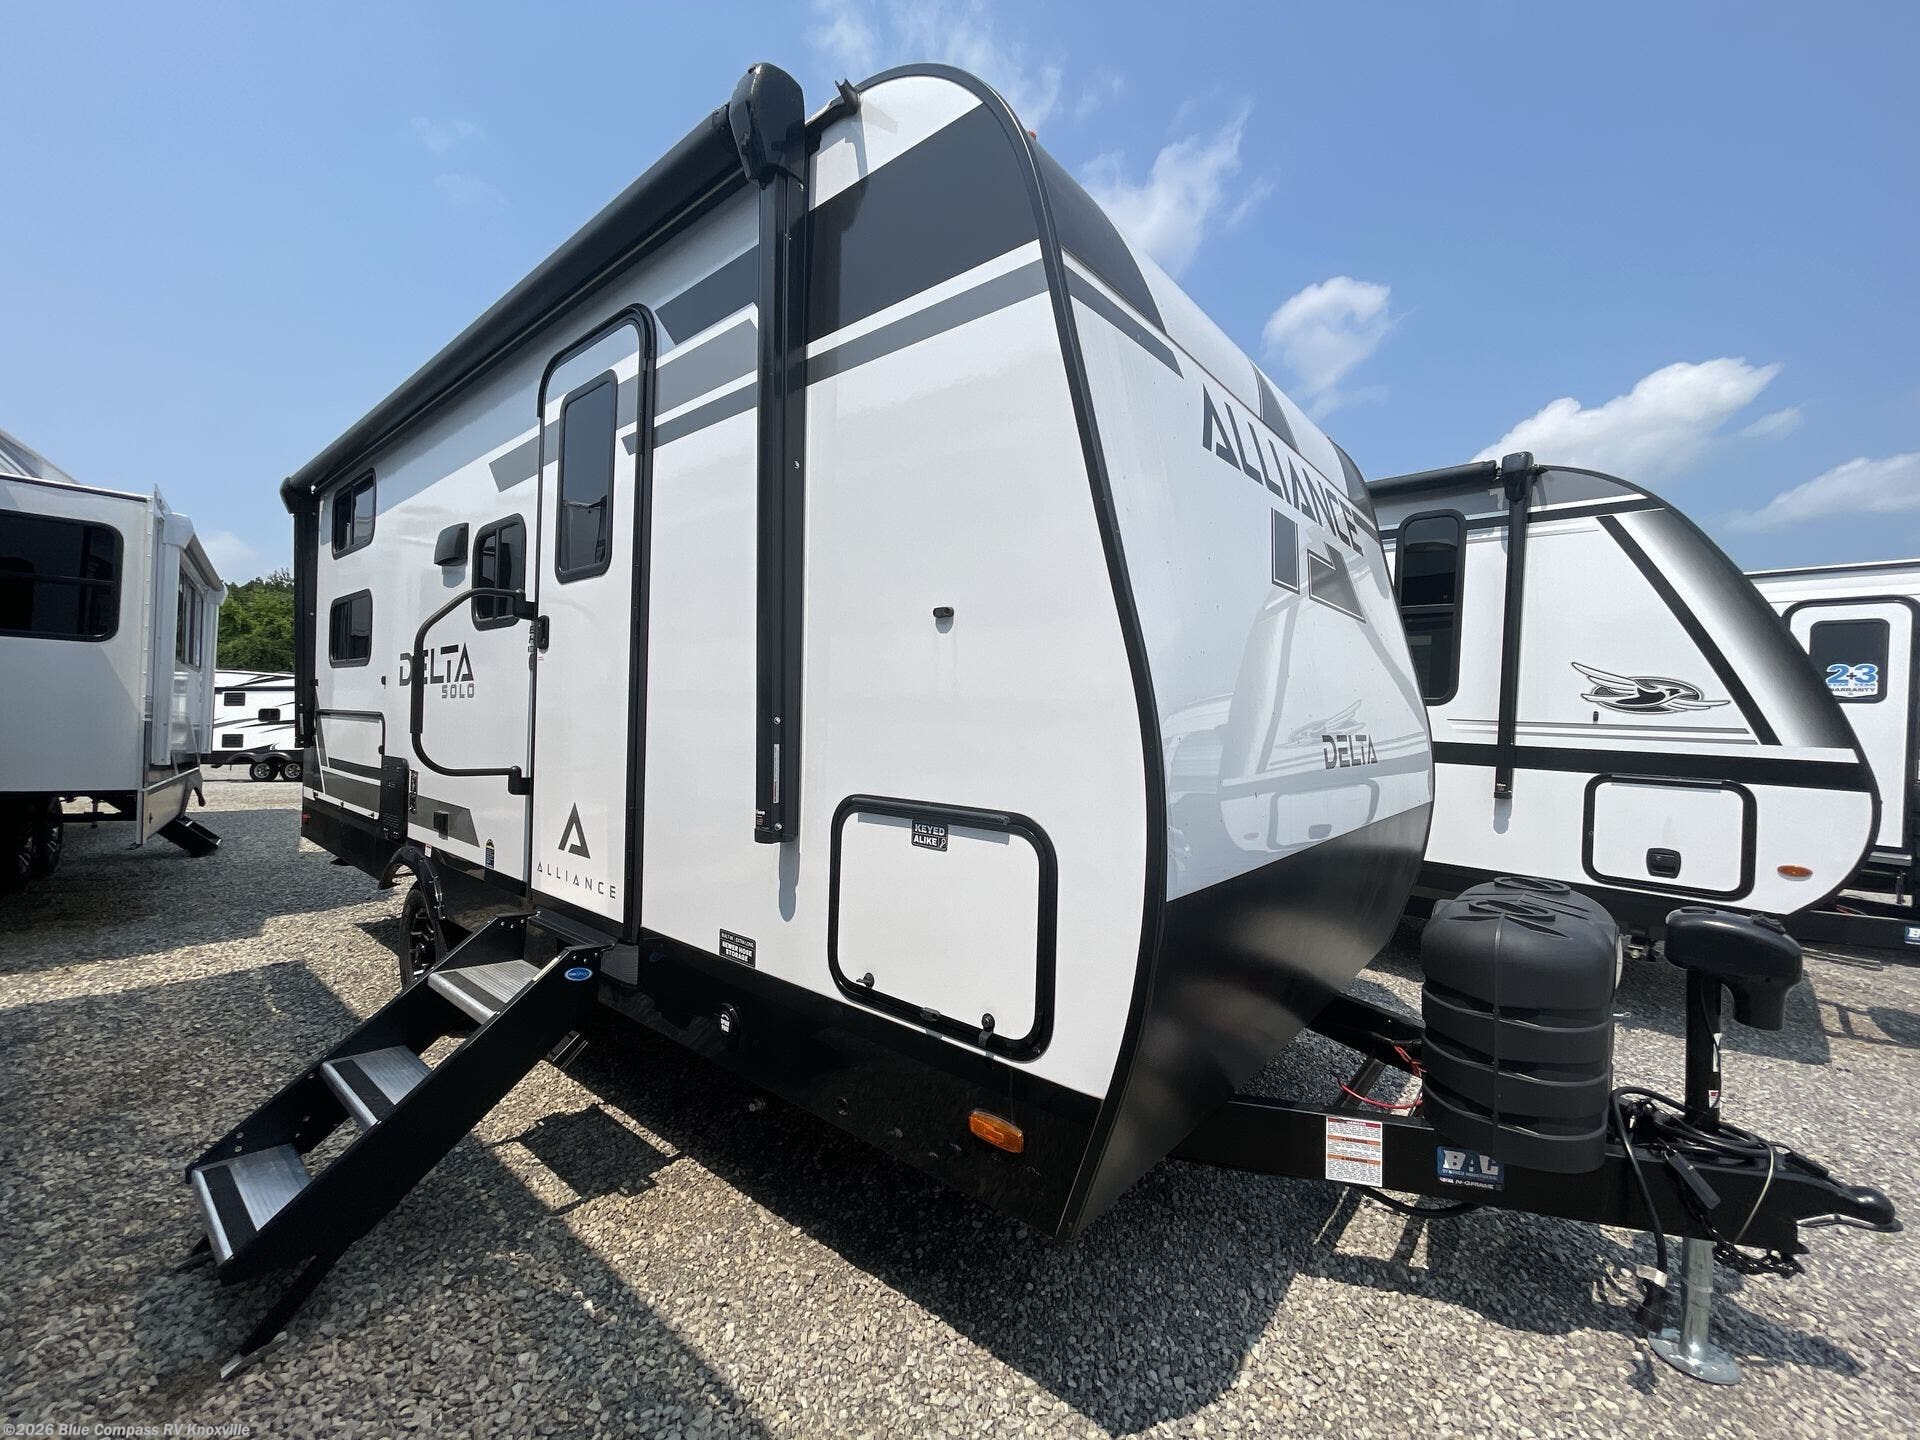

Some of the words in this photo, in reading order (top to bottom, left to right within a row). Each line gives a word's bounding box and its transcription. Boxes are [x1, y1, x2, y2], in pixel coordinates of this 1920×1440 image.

[1202, 383, 1364, 557] ALLIANCE
[441, 683, 475, 699] SOLO
[1322, 733, 1378, 770] DELTA
[915, 824, 945, 836] KEYED
[914, 835, 938, 846] ALIKE
[537, 861, 616, 899] ALLIANCE
[722, 941, 738, 952] SEWER
[739, 946, 752, 957] HOSE
